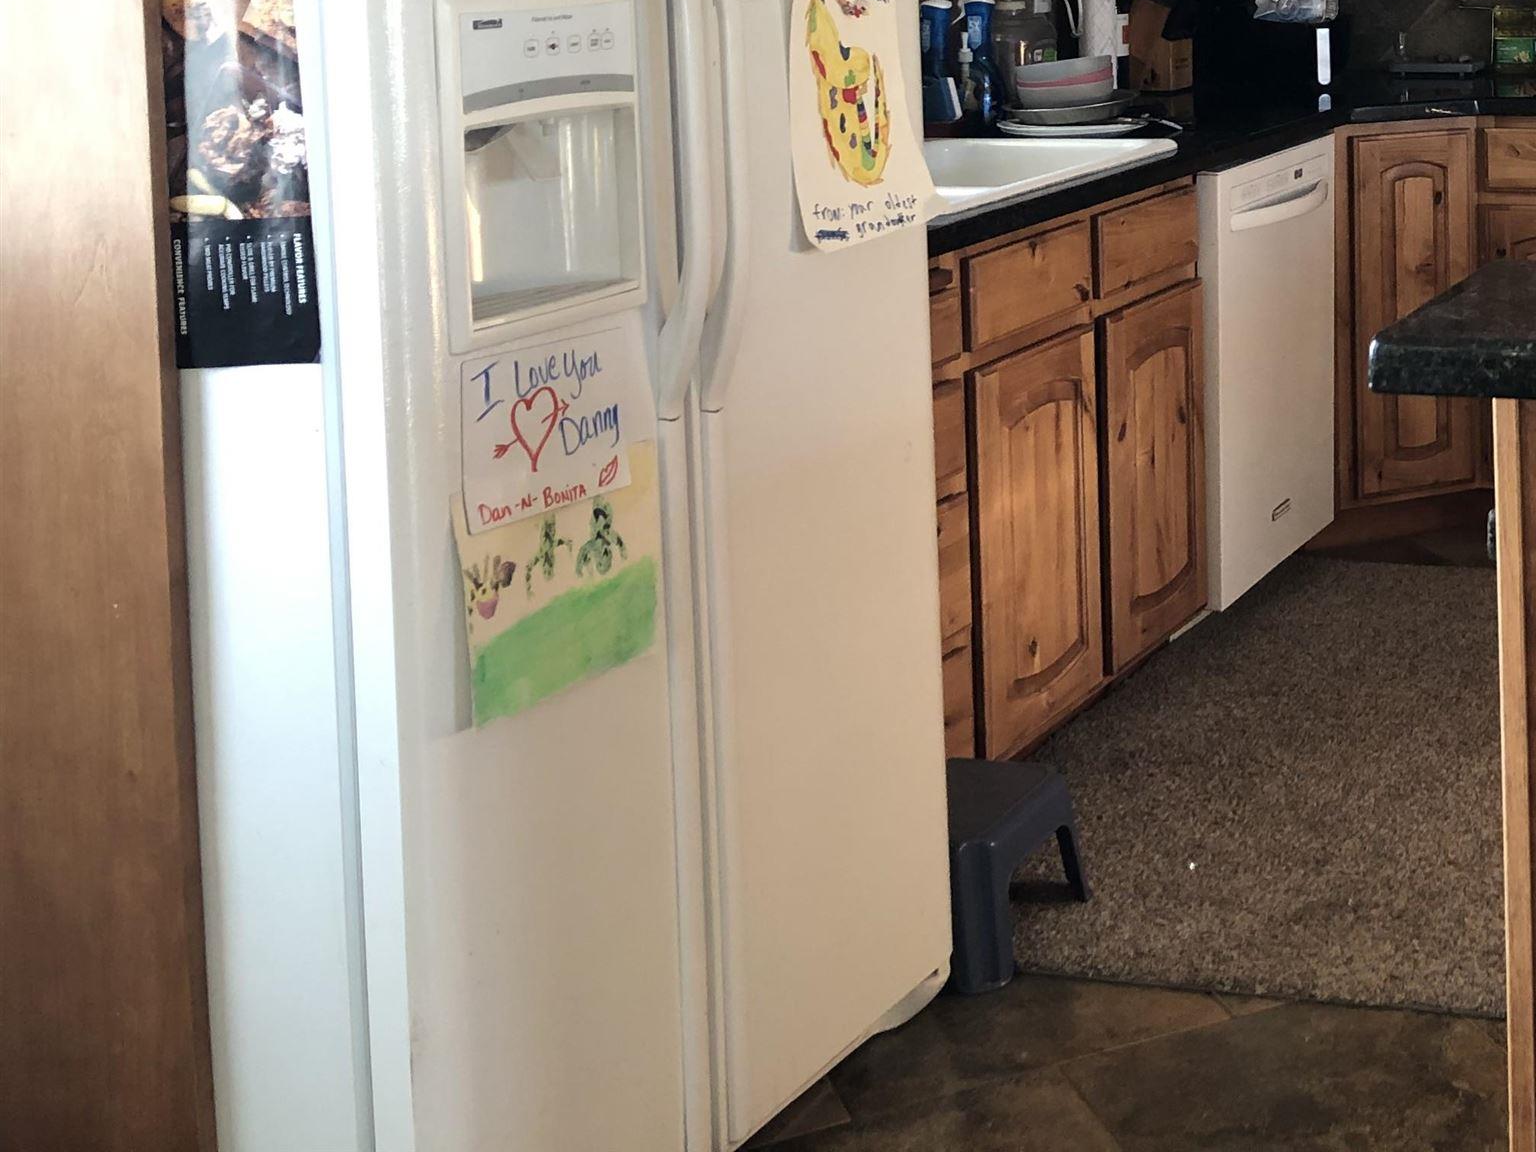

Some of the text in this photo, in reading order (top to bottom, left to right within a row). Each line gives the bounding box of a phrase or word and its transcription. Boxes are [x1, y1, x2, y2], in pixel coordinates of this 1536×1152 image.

[293, 232, 307, 304] FLAVOR FEATURES
[177, 297, 188, 335] FEATURES
[470, 348, 603, 423] I Love You
[558, 402, 621, 457] Danny
[478, 503, 512, 525] Dan
